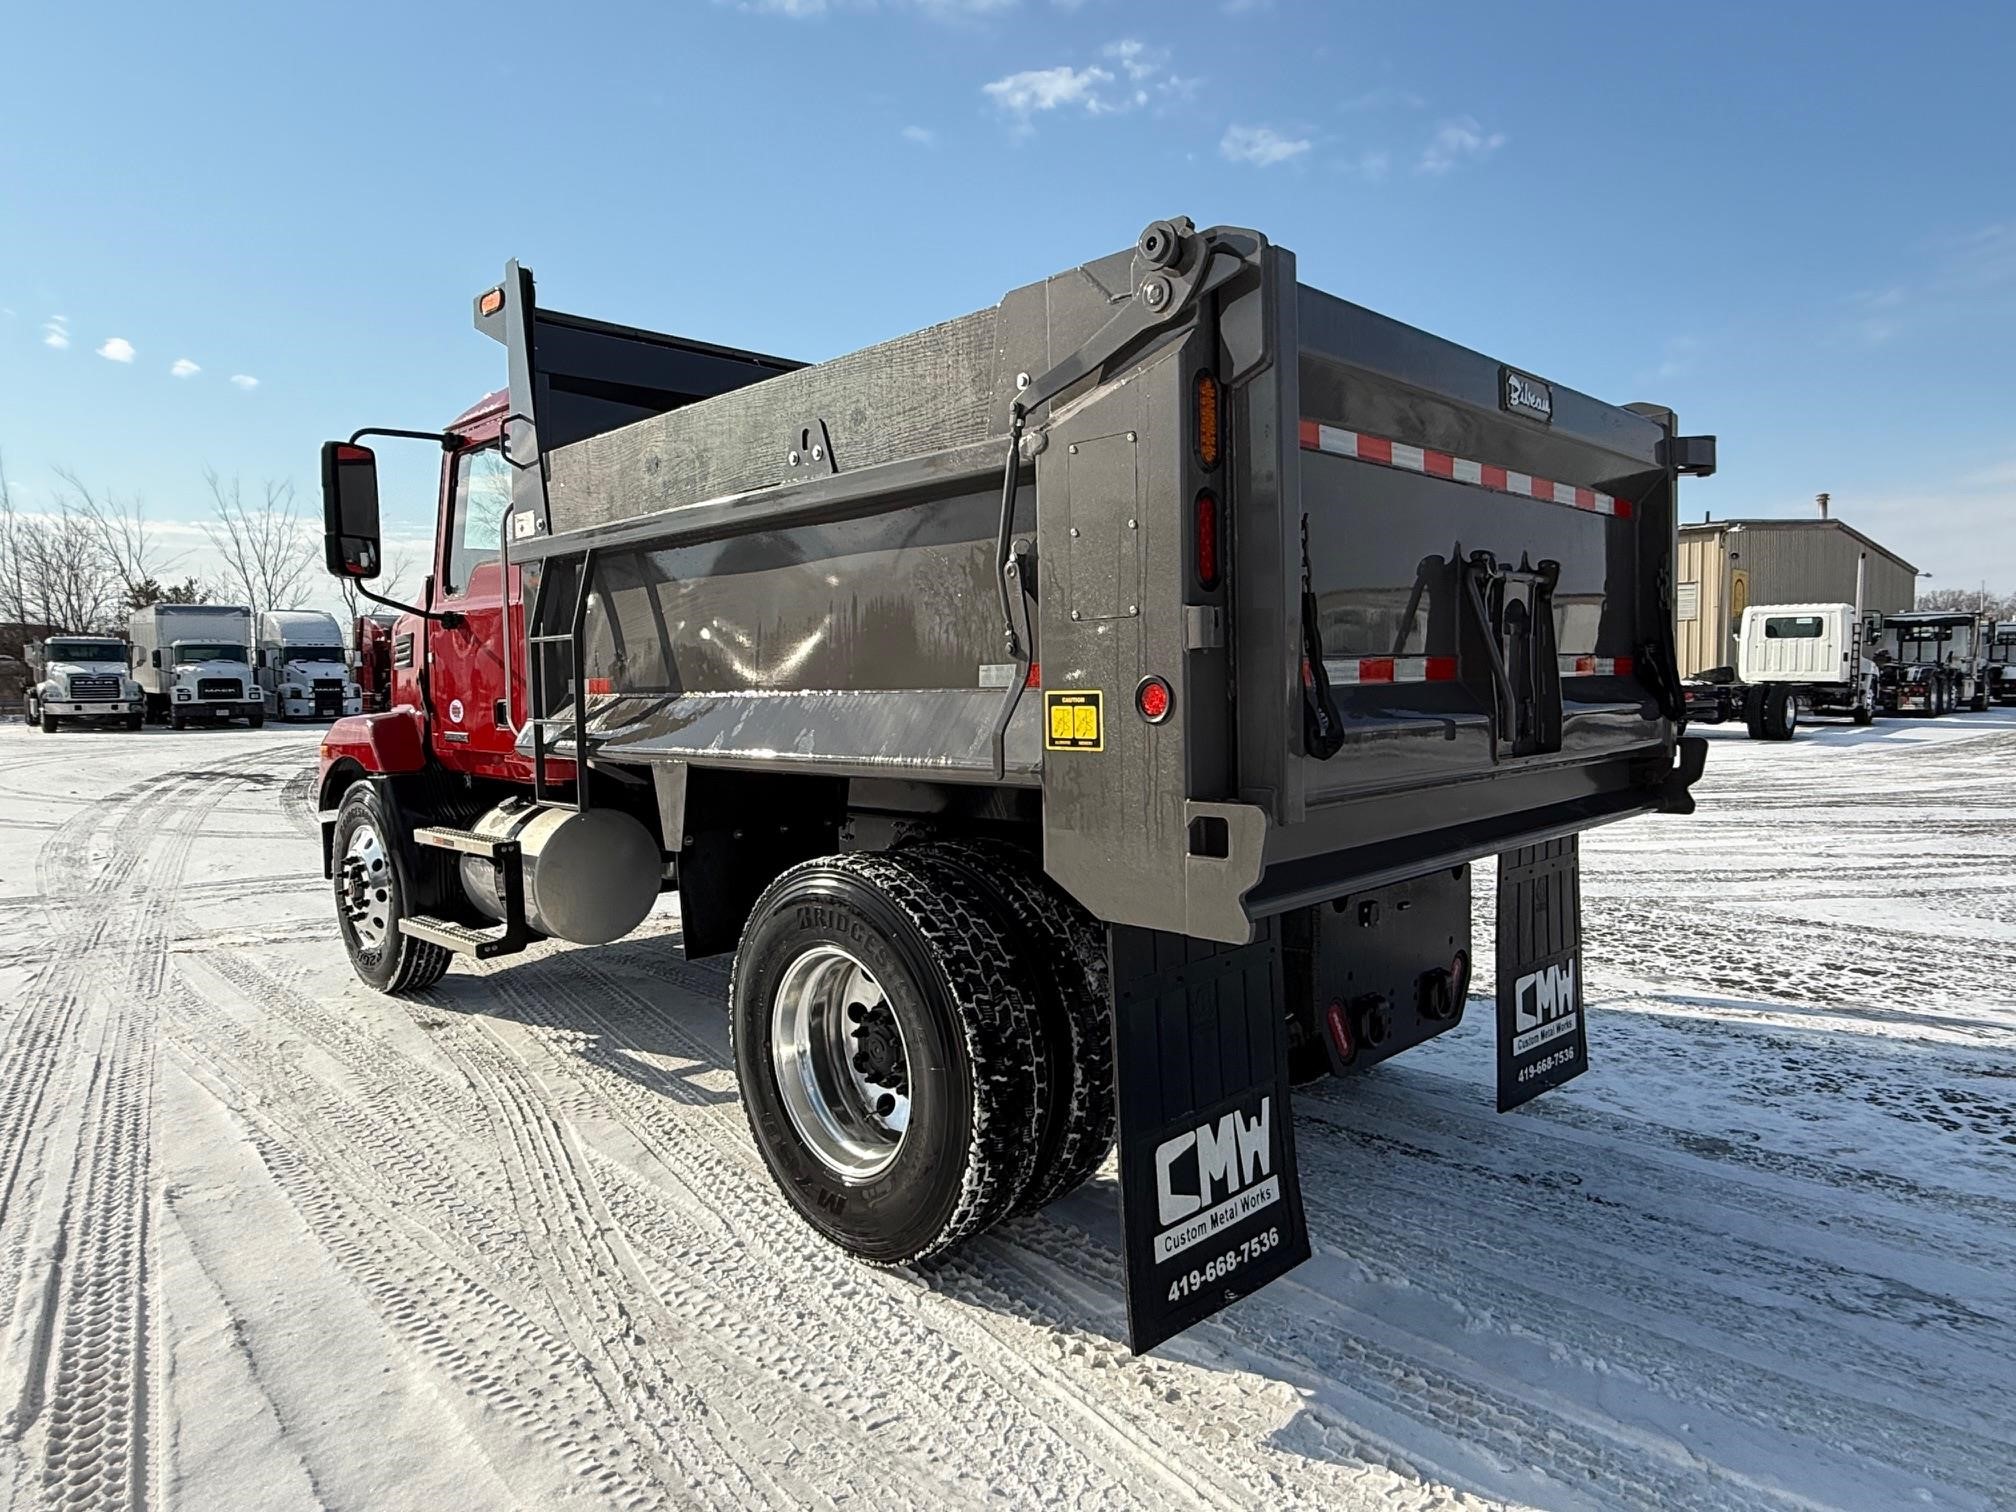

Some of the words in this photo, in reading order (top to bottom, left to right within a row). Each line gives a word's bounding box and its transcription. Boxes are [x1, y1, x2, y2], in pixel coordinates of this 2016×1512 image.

[1515, 958, 1574, 1033] CMW
[1517, 1033, 1540, 1051] Custom
[1541, 1027, 1555, 1042] Metal
[1556, 1019, 1573, 1034] Works
[1517, 1046, 1574, 1083] 419-668-7536
[1155, 1096, 1270, 1226] CMW
[1164, 1223, 1208, 1252] Custom
[1210, 1205, 1238, 1229] Metal
[1241, 1186, 1272, 1212] Works
[1168, 1227, 1279, 1302] 419-668-7536
